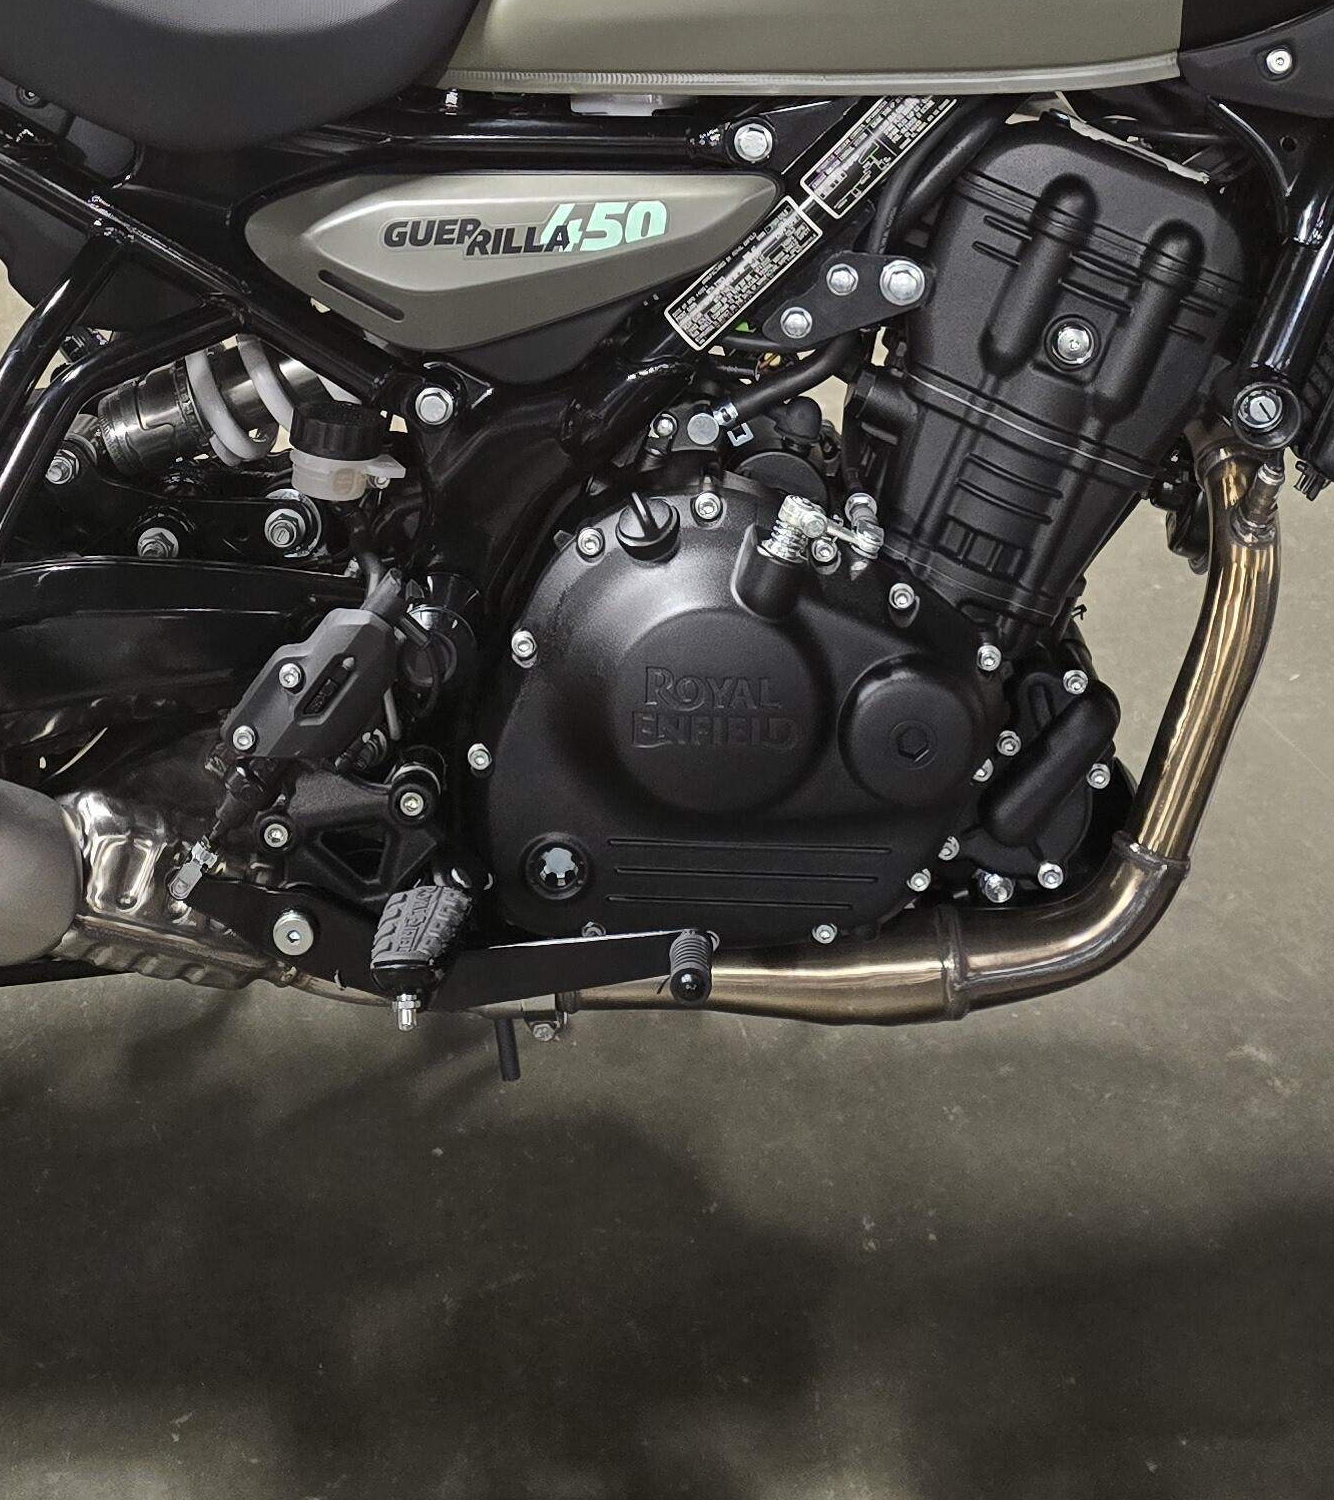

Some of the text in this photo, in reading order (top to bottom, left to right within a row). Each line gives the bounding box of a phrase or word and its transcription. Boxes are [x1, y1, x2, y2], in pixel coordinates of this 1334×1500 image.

[383, 200, 667, 256] GUERRILLA 450
[644, 665, 782, 712] ROYAL
[631, 711, 799, 749] ENFIELD
